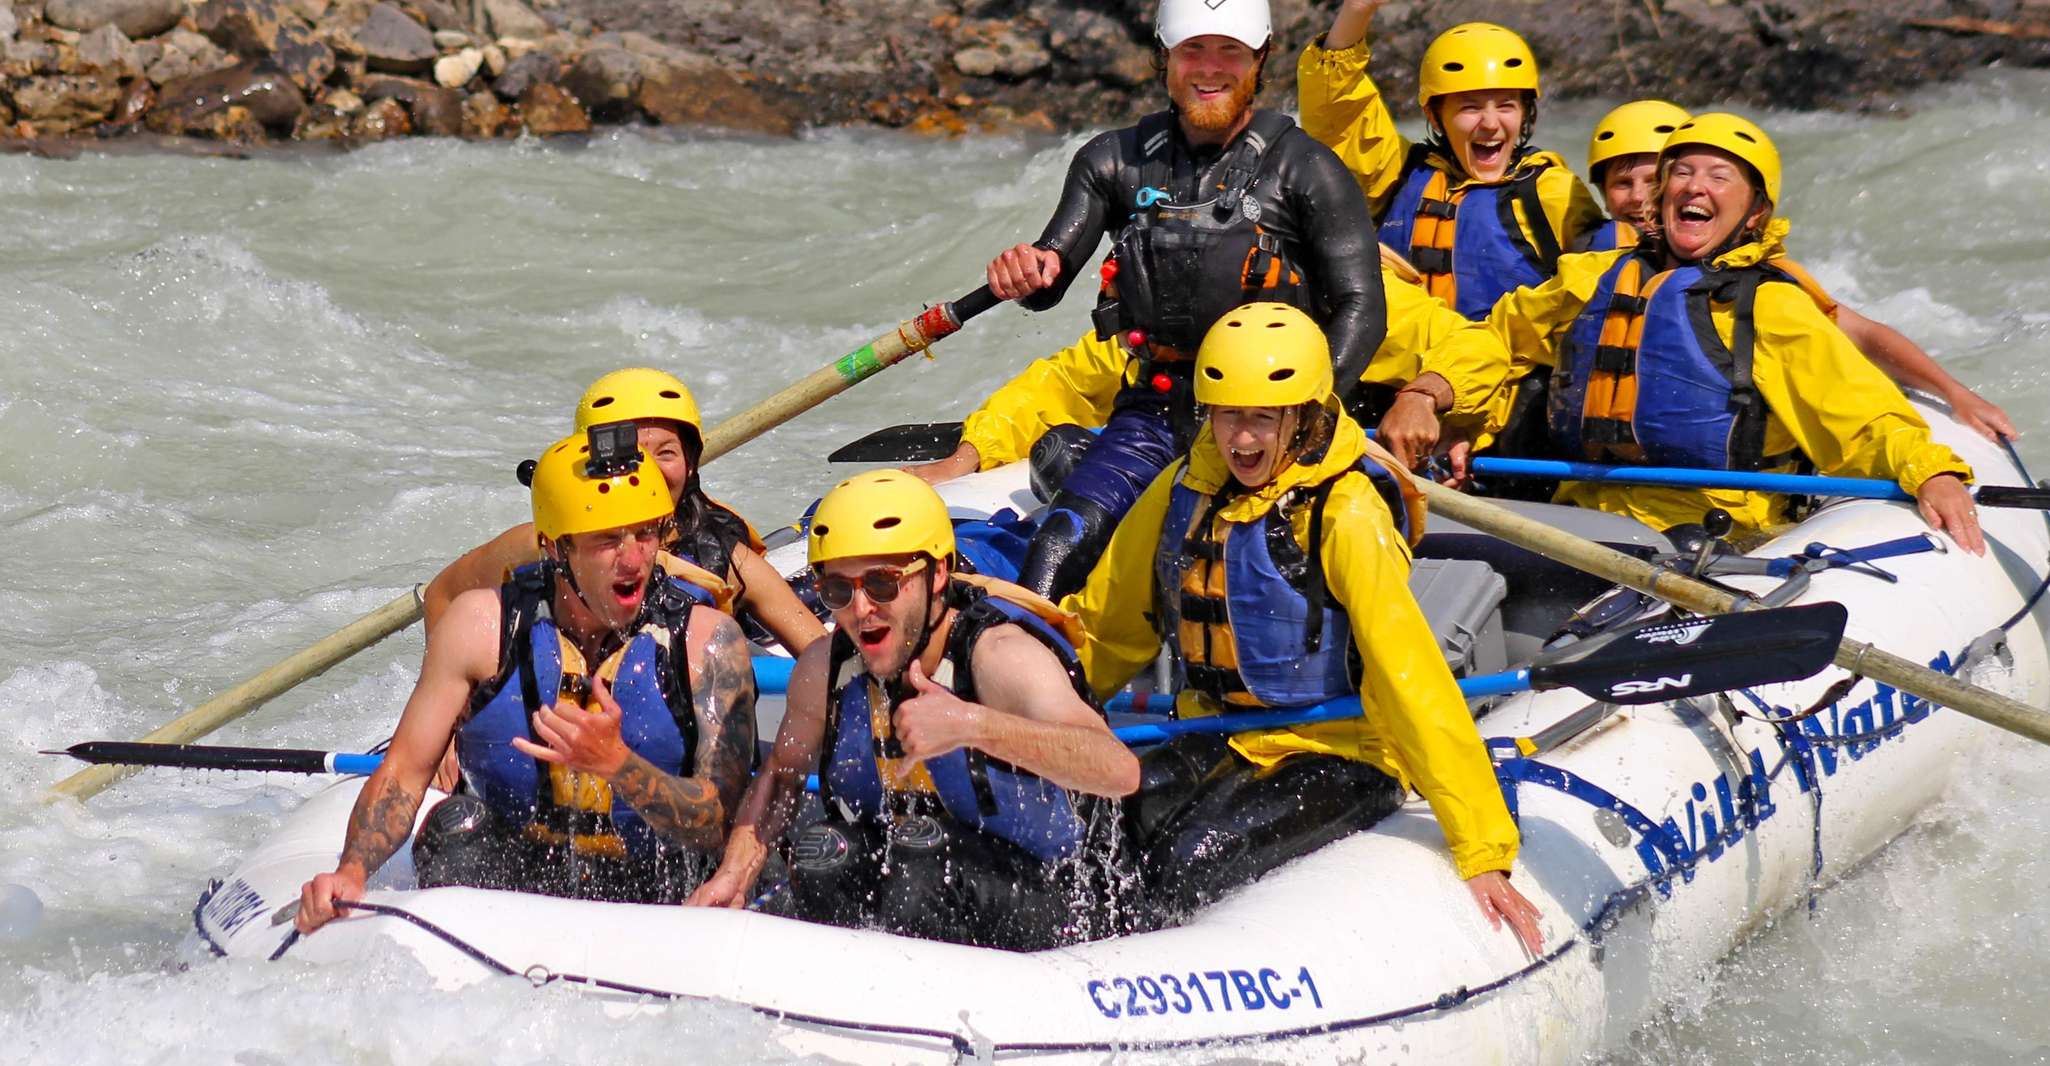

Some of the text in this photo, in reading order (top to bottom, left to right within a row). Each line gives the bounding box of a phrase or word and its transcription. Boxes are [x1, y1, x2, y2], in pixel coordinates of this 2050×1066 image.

[1611, 673, 1692, 697] NRS
[1634, 746, 1777, 900] Wild
[1087, 966, 1323, 1019] C29317BC-1
